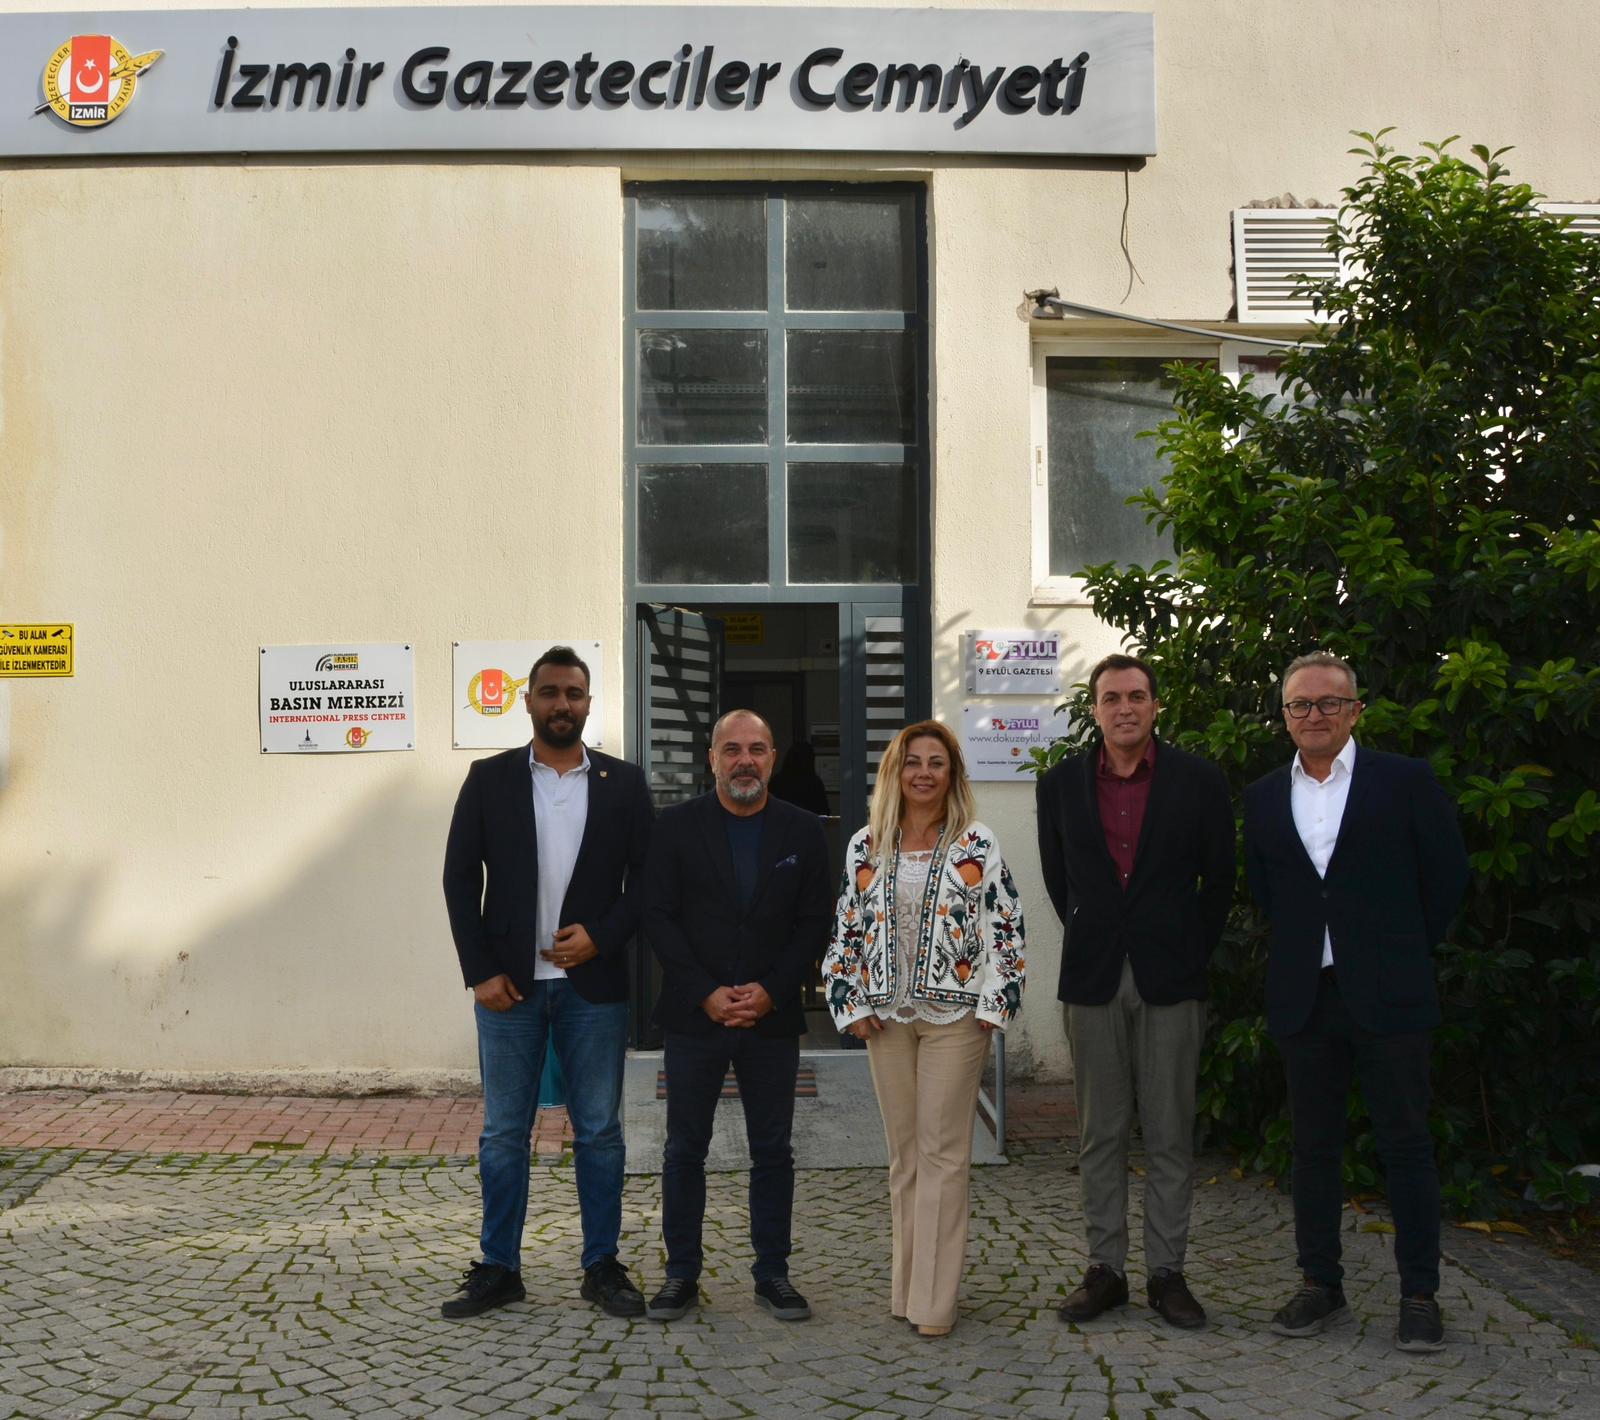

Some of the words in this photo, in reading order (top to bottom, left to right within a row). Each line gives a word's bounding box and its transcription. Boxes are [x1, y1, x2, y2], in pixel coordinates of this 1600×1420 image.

[47, 47, 70, 111] GAZETECİLER
[111, 49, 132, 112] CEMİYETİ
[214, 35, 385, 108] İzmir
[401, 43, 782, 107] Gazeteciler
[800, 47, 1090, 126] Cemiyeti
[71, 106, 106, 119] İZMİR
[19, 630, 28, 640] BU
[30, 630, 47, 640] ALAN
[0, 643, 32, 655] GÜVENLİK
[34, 645, 67, 655] KAMERASI
[12, 659, 66, 670] İZLENMEKTEDİR
[986, 666, 1011, 675] EYLÜL
[1013, 667, 1053, 675] GAZETESİ
[289, 679, 384, 691] ULUSLARARASI
[270, 697, 321, 711] BASIN
[327, 691, 404, 710] MERKEZİ
[269, 714, 340, 723] INTERNATIONAL
[343, 713, 368, 721] PRESS
[371, 712, 406, 721] CENTER
